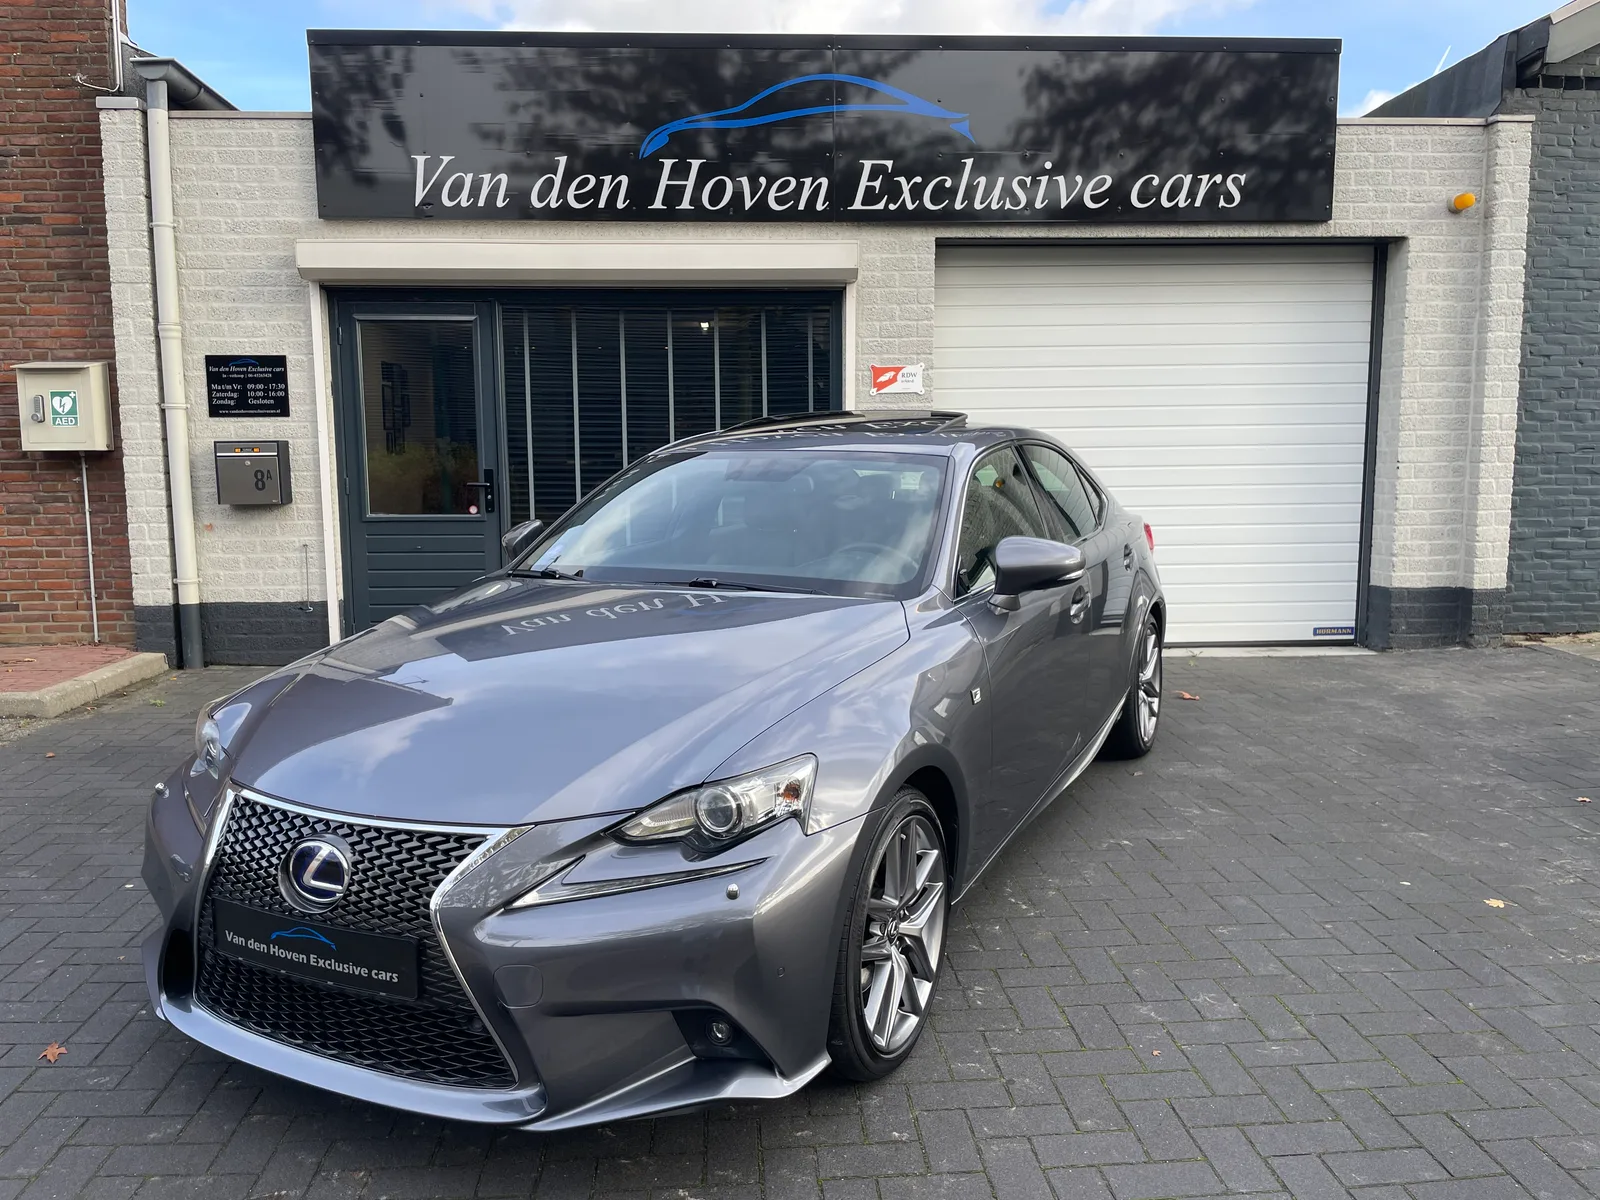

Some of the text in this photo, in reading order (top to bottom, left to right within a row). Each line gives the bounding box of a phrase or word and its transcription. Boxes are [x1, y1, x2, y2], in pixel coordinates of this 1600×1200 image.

[411, 155, 1247, 212] Van den Hoven Exclusive cars
[56, 418, 76, 426] AED
[225, 930, 398, 983] Van den Hoven Exclusive cars
